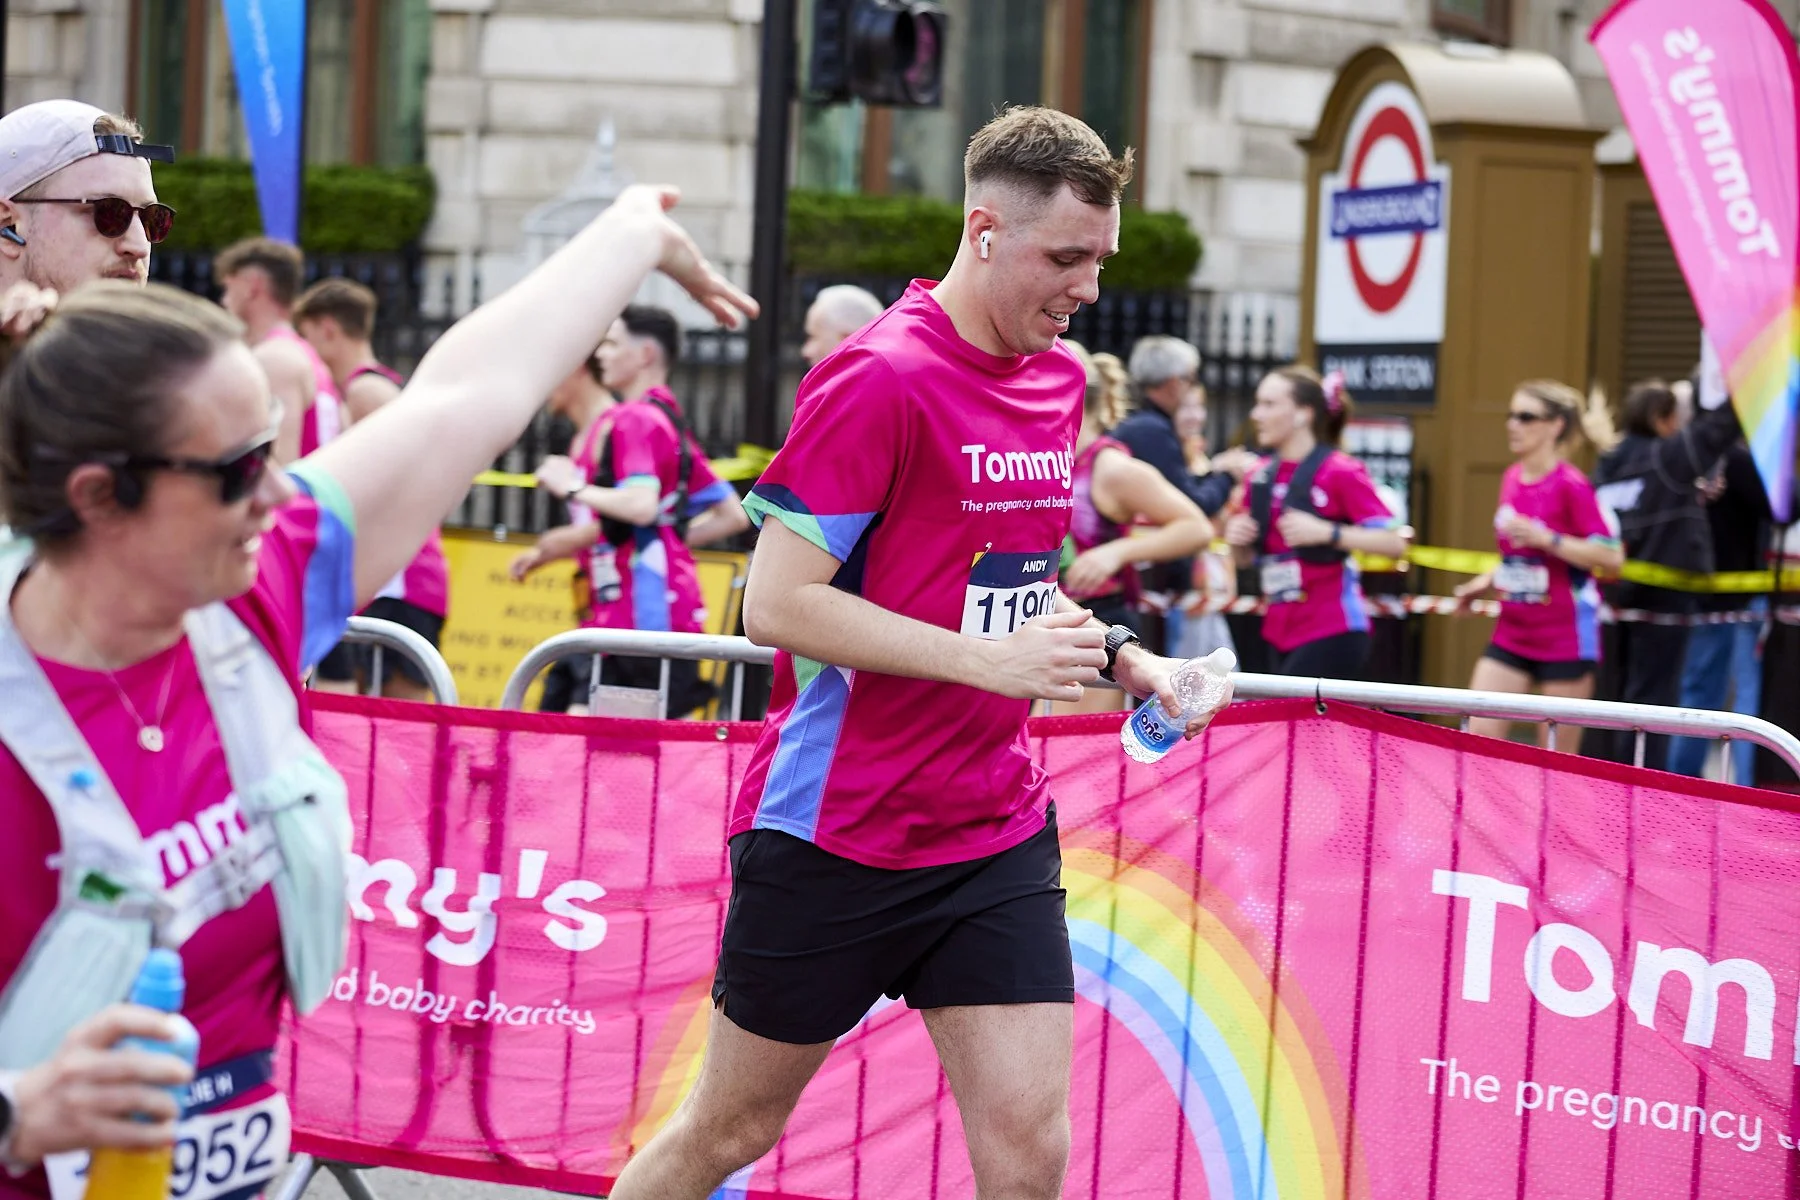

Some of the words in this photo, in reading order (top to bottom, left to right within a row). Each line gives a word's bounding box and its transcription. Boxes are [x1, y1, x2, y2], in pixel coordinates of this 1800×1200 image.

[961, 499, 983, 512] The
[985, 499, 1032, 513] pregnancy
[1034, 495, 1051, 508] and
[1022, 559, 1048, 573] ANDY
[1141, 713, 1164, 742] one
[345, 848, 608, 967] my's
[365, 970, 456, 1024] baby
[463, 990, 597, 1035] charity
[1432, 869, 1800, 1065] Tom
[1420, 1057, 1500, 1103] The
[1514, 1079, 1762, 1152] pregnancy
[170, 1111, 273, 1198] 952
